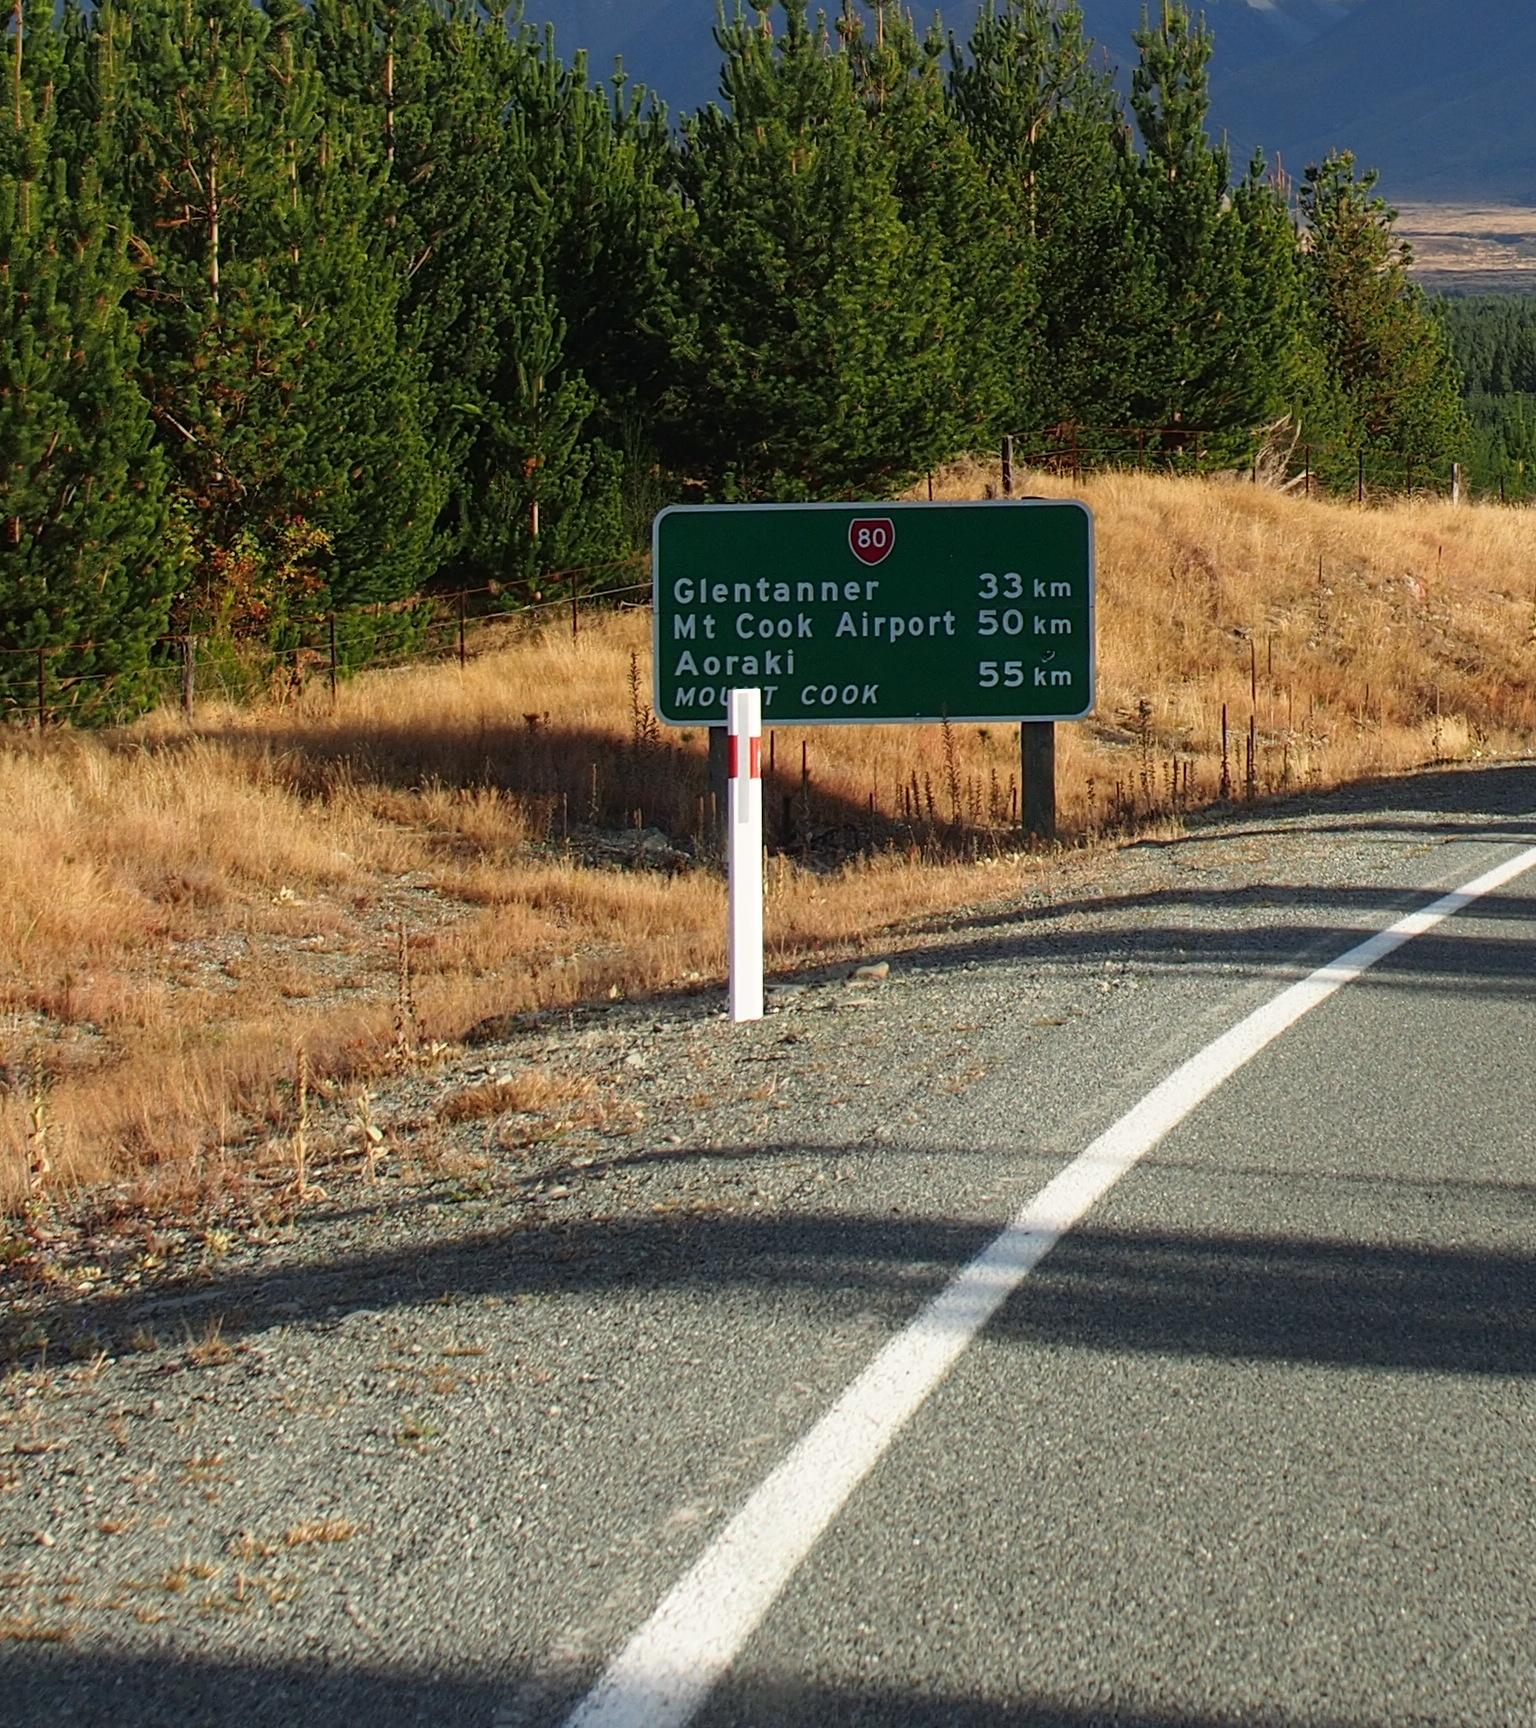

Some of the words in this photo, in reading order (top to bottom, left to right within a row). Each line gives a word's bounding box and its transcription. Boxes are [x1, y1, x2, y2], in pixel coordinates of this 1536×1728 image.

[858, 528, 887, 548] 80
[674, 577, 879, 604] Glentanner
[978, 573, 1024, 599] 33
[1033, 578, 1072, 598] km
[674, 613, 716, 640] Mt
[736, 613, 814, 639] Cook
[835, 610, 956, 643] Airport
[978, 609, 1024, 636] 50
[1033, 615, 1072, 635] km
[674, 649, 795, 676] Aoraki
[979, 661, 1025, 688] 55
[1033, 667, 1072, 687] km
[675, 686, 778, 706] MOUT
[801, 684, 879, 705] COOK
